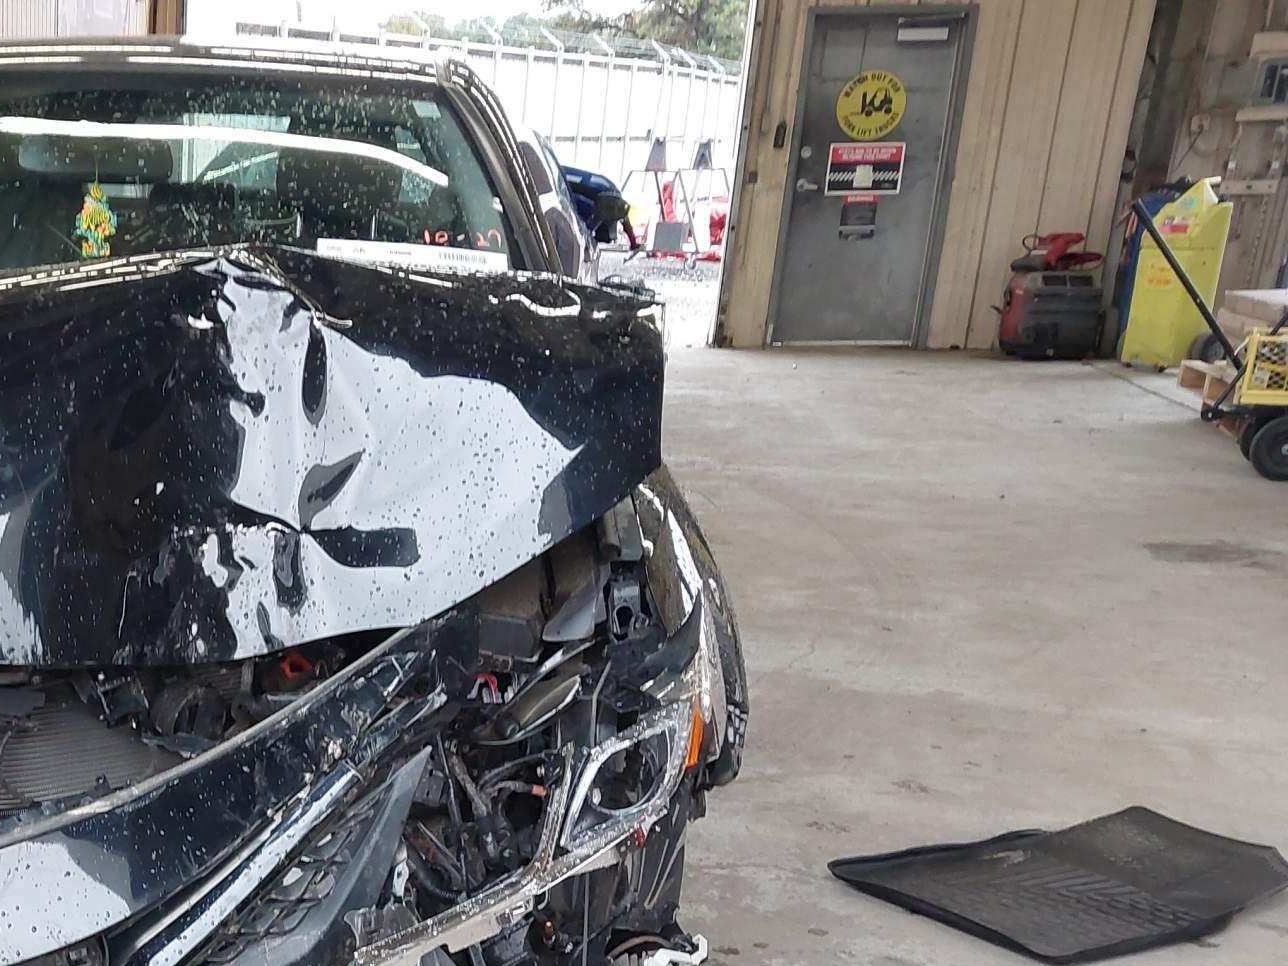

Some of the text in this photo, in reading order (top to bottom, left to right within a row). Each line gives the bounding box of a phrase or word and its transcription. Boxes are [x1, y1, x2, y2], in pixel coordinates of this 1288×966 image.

[843, 72, 901, 97] WATCH OUT FOR
